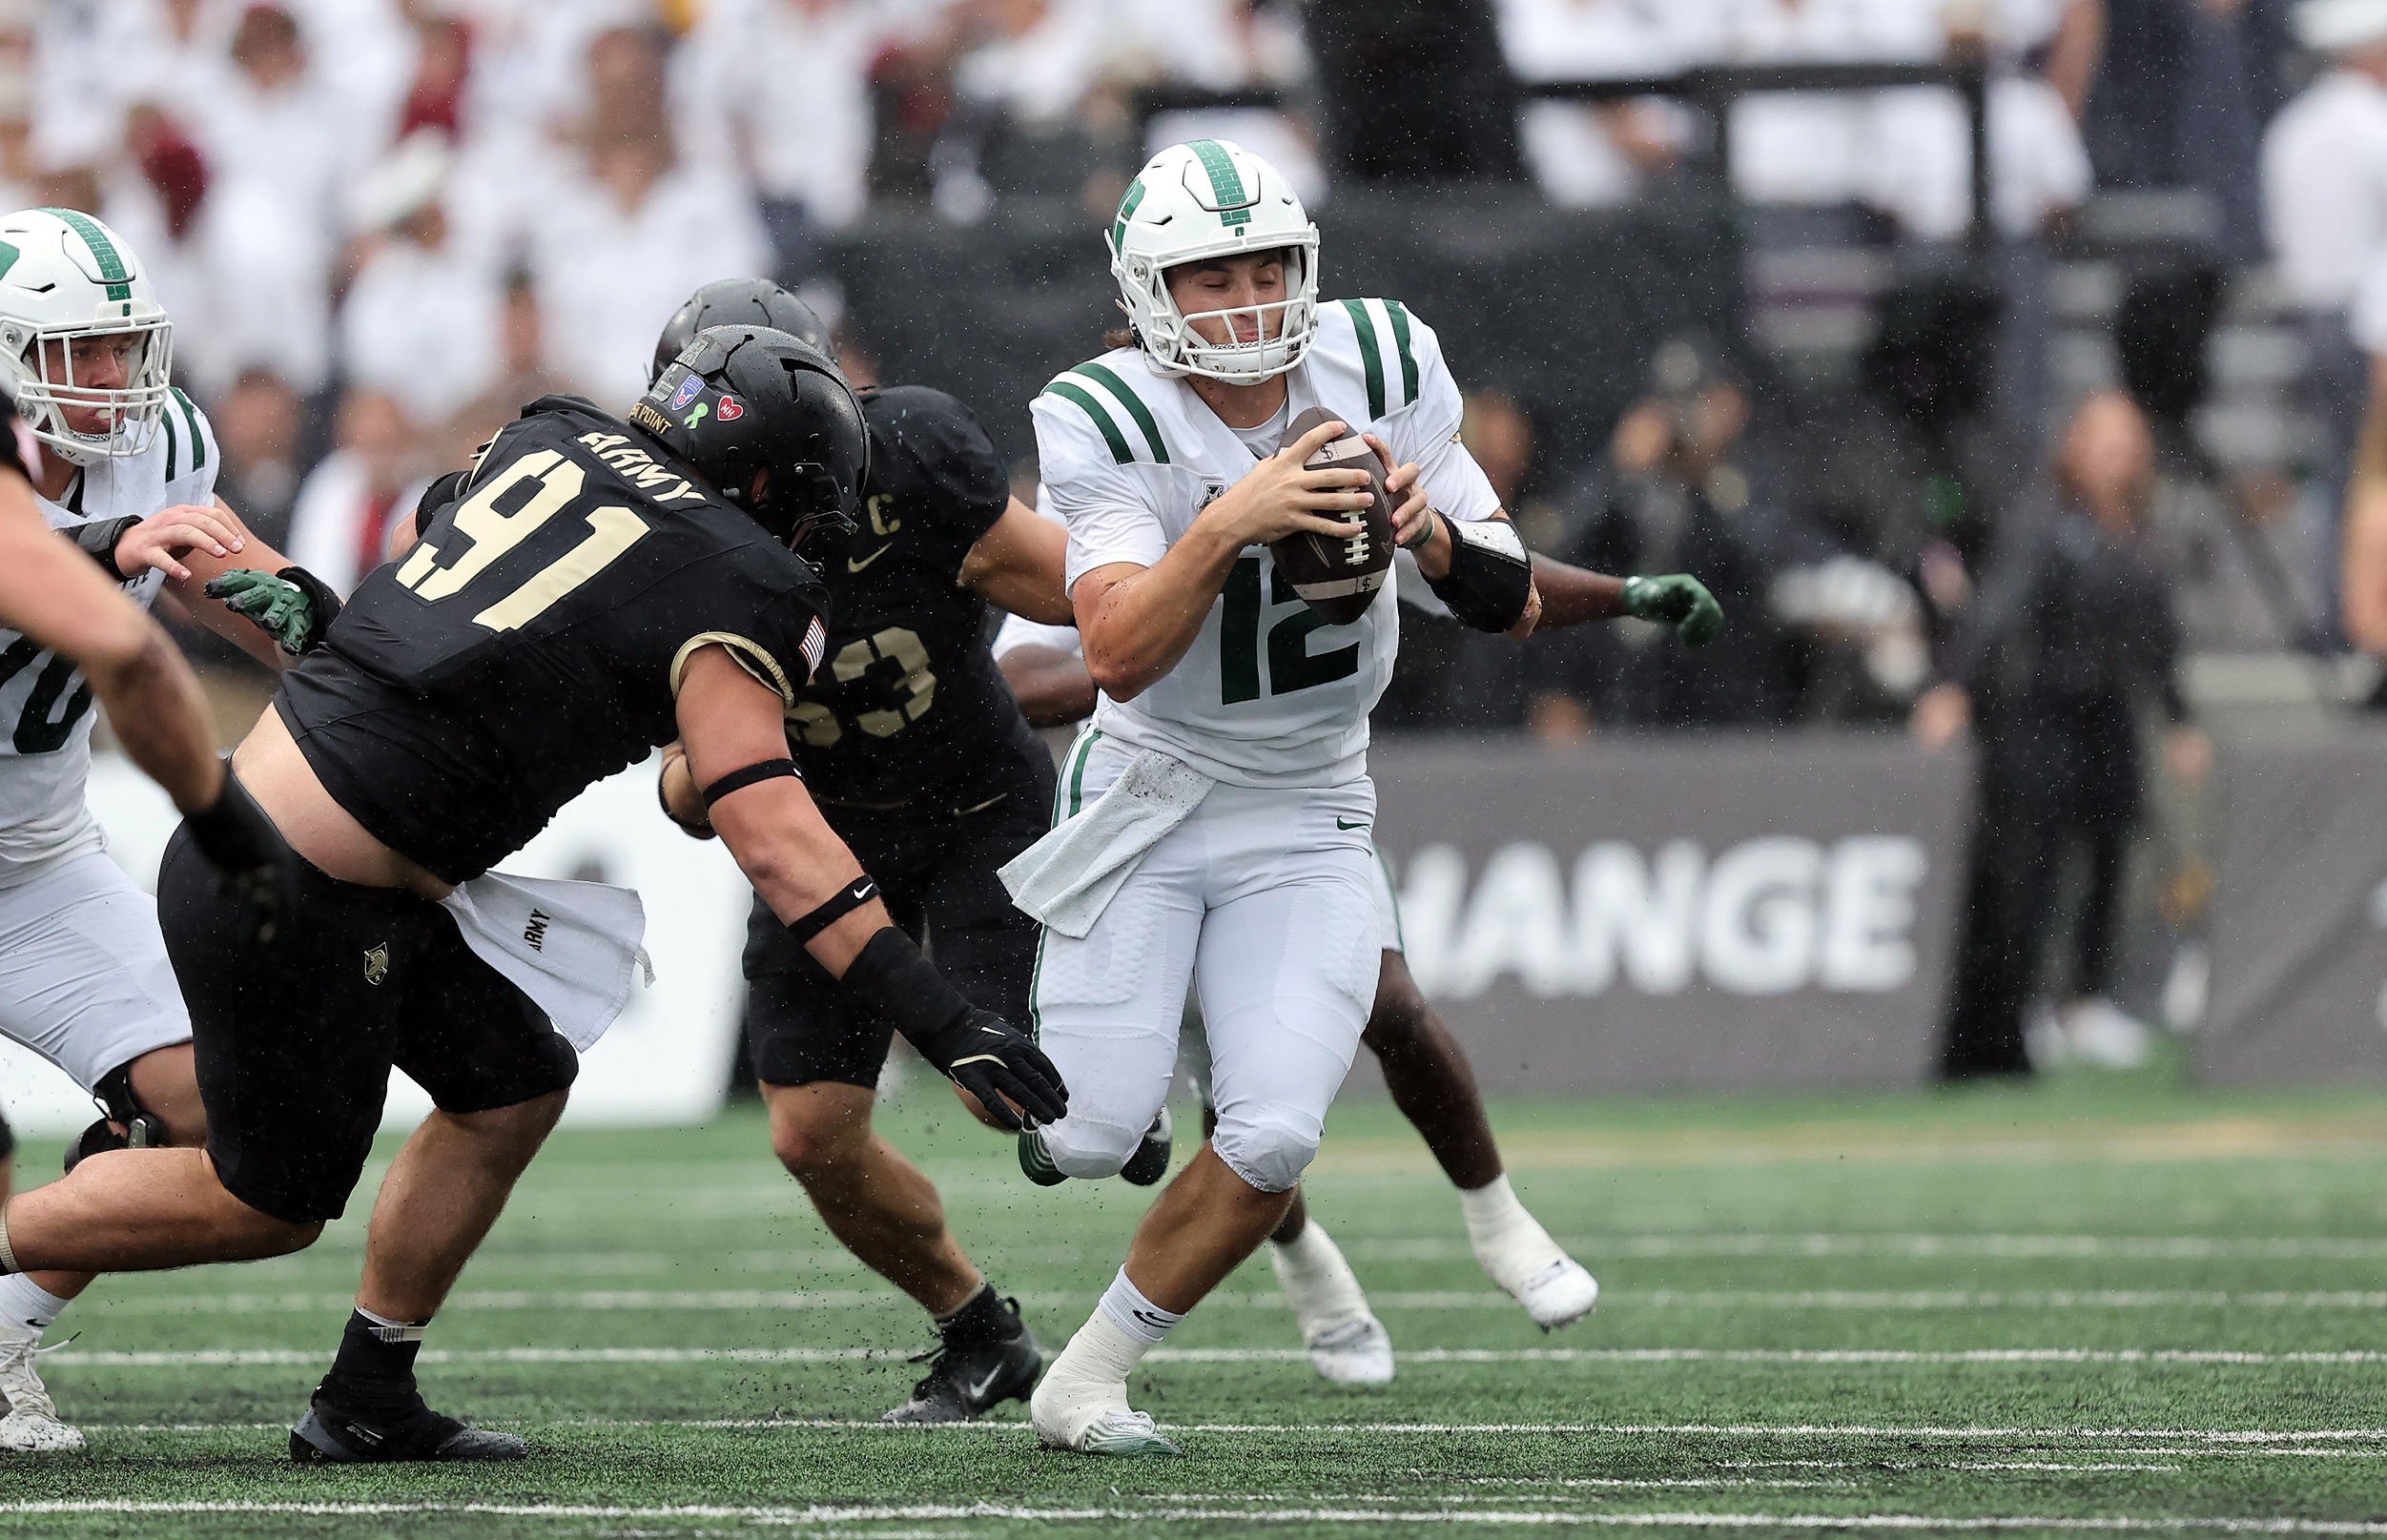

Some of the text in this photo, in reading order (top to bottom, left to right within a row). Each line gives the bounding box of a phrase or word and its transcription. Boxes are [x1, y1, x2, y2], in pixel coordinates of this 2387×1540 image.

[639, 404, 673, 435] POINT
[720, 403, 735, 418] MH
[577, 430, 707, 503] ARMY
[867, 493, 901, 536] C
[395, 448, 651, 633] 91
[1221, 558, 1361, 706] 12
[523, 908, 550, 954] ARMY
